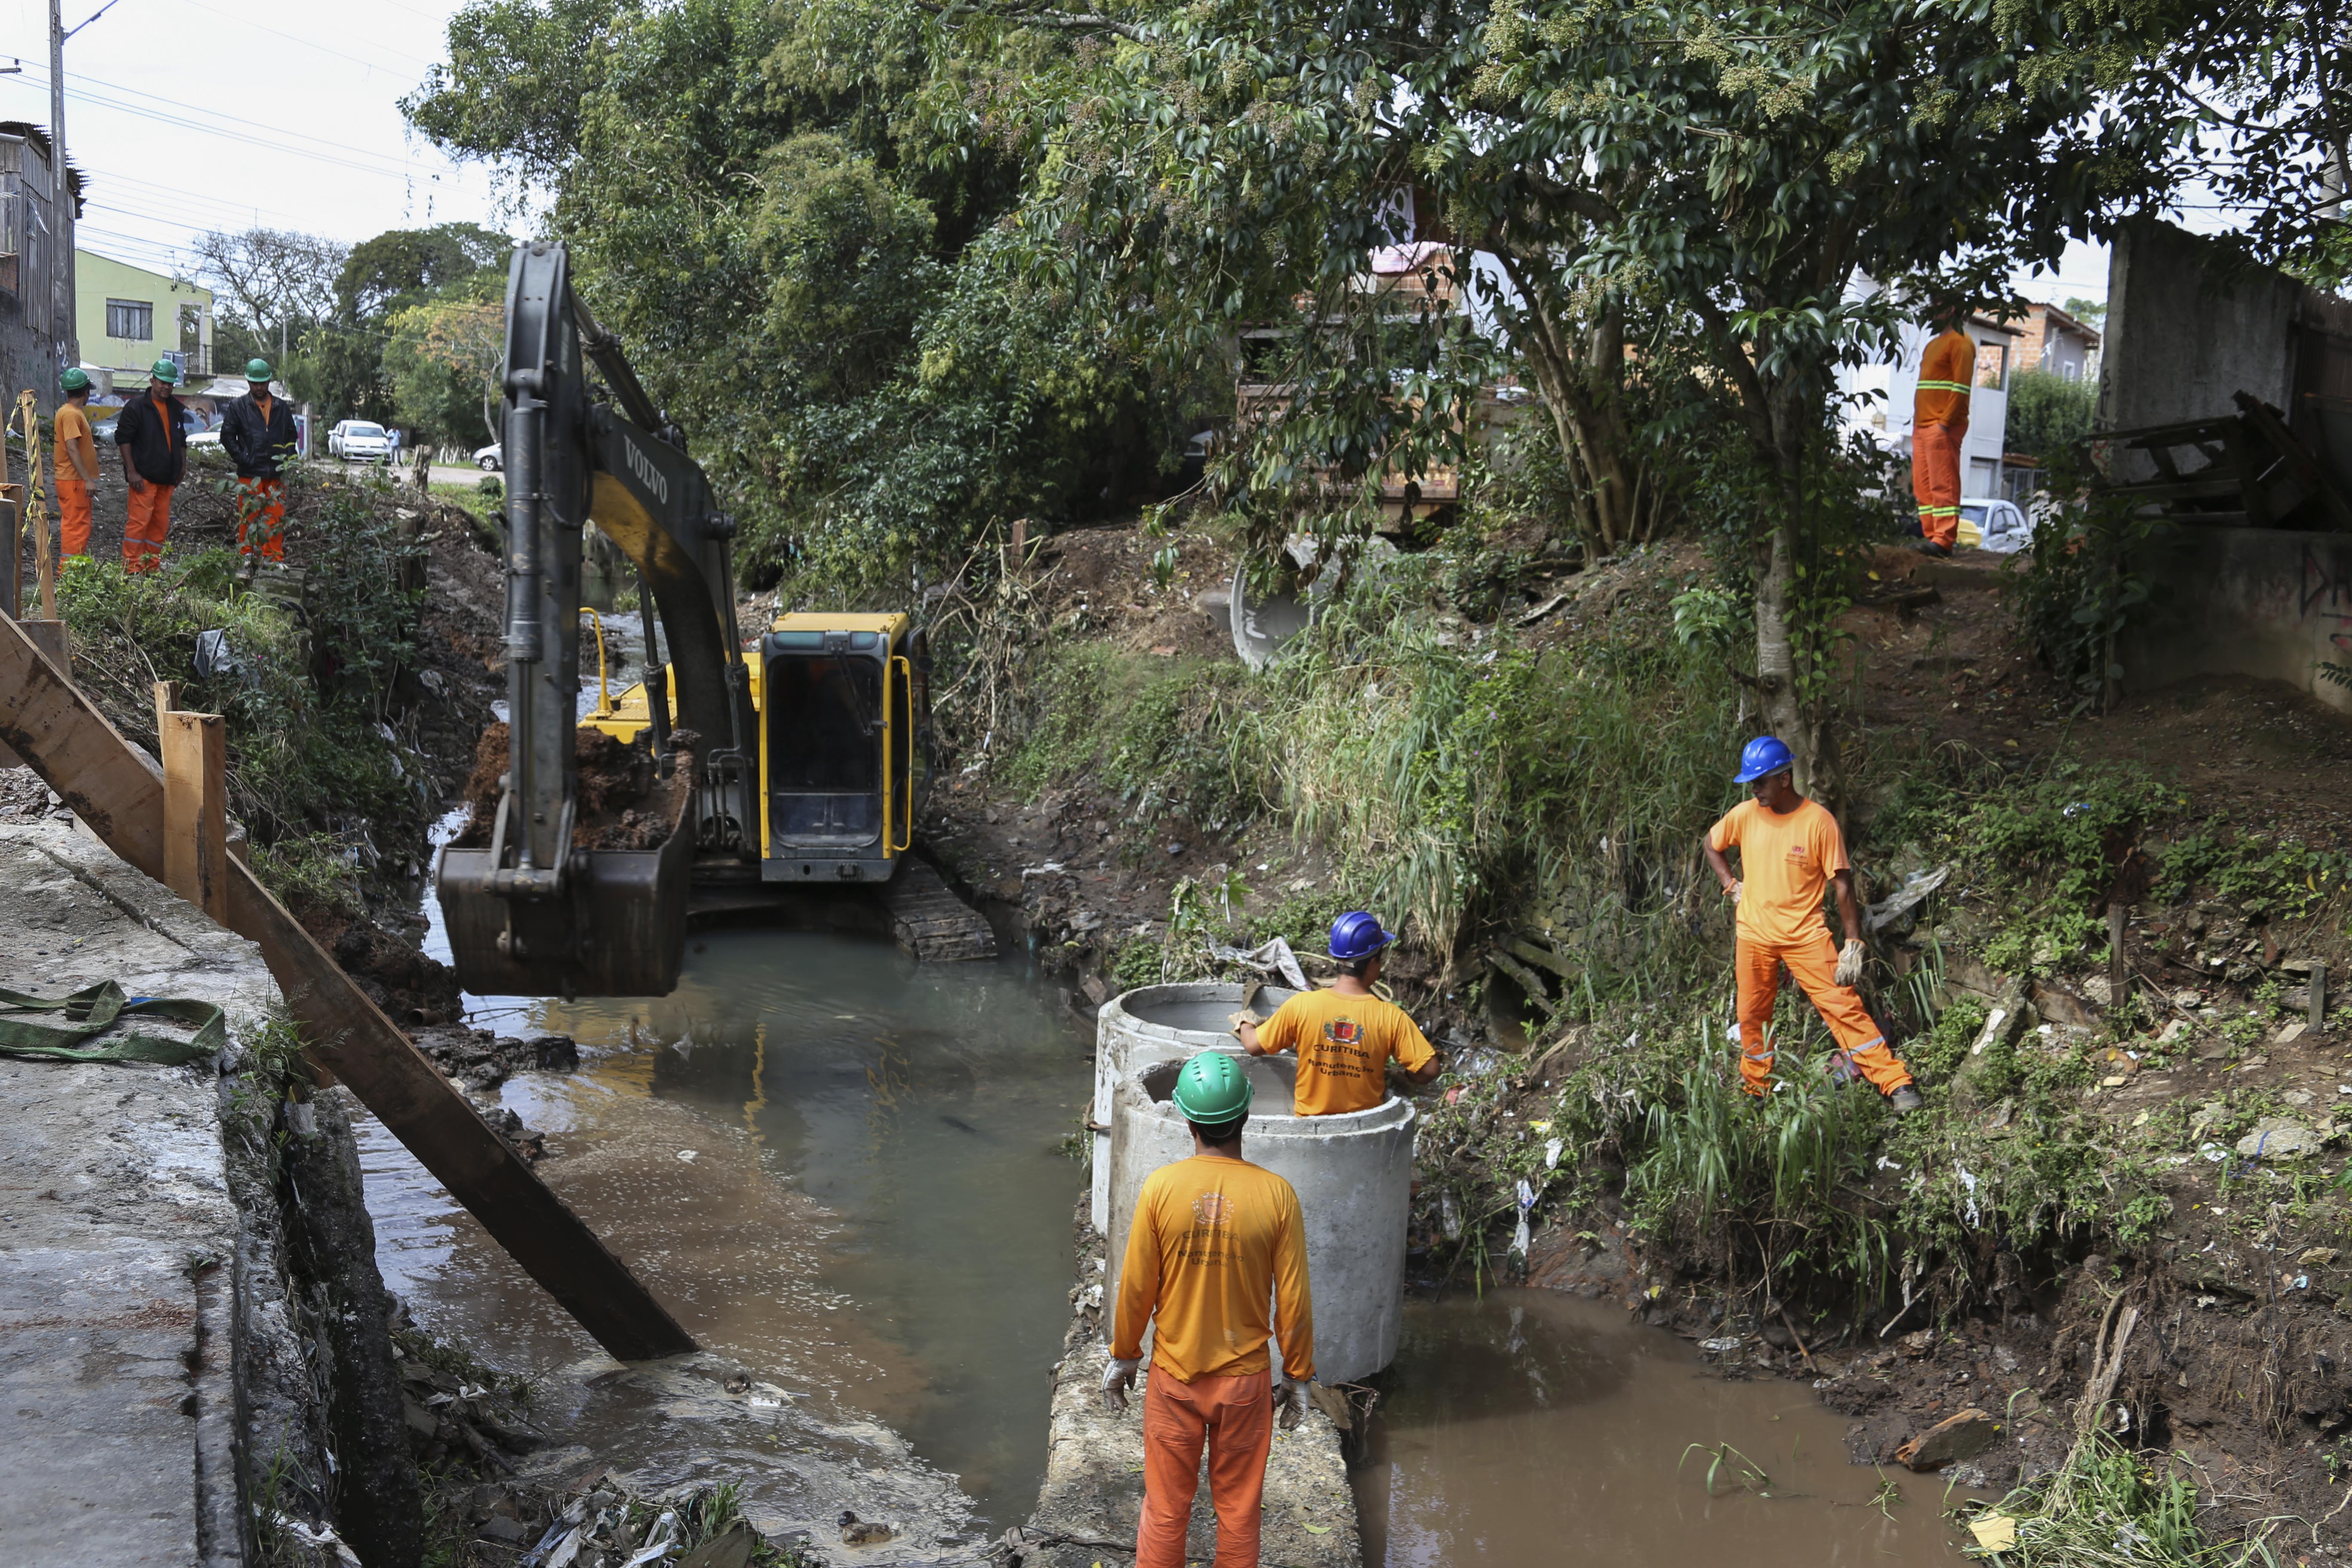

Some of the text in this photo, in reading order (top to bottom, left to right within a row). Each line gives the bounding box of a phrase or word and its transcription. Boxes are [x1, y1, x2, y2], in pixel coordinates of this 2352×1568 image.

[624, 433, 667, 505] VOLVO
[1314, 1044, 1370, 1059] CURITIBA
[1320, 1068, 1360, 1078] Urbana
[1182, 1229, 1239, 1241] CURITIBA
